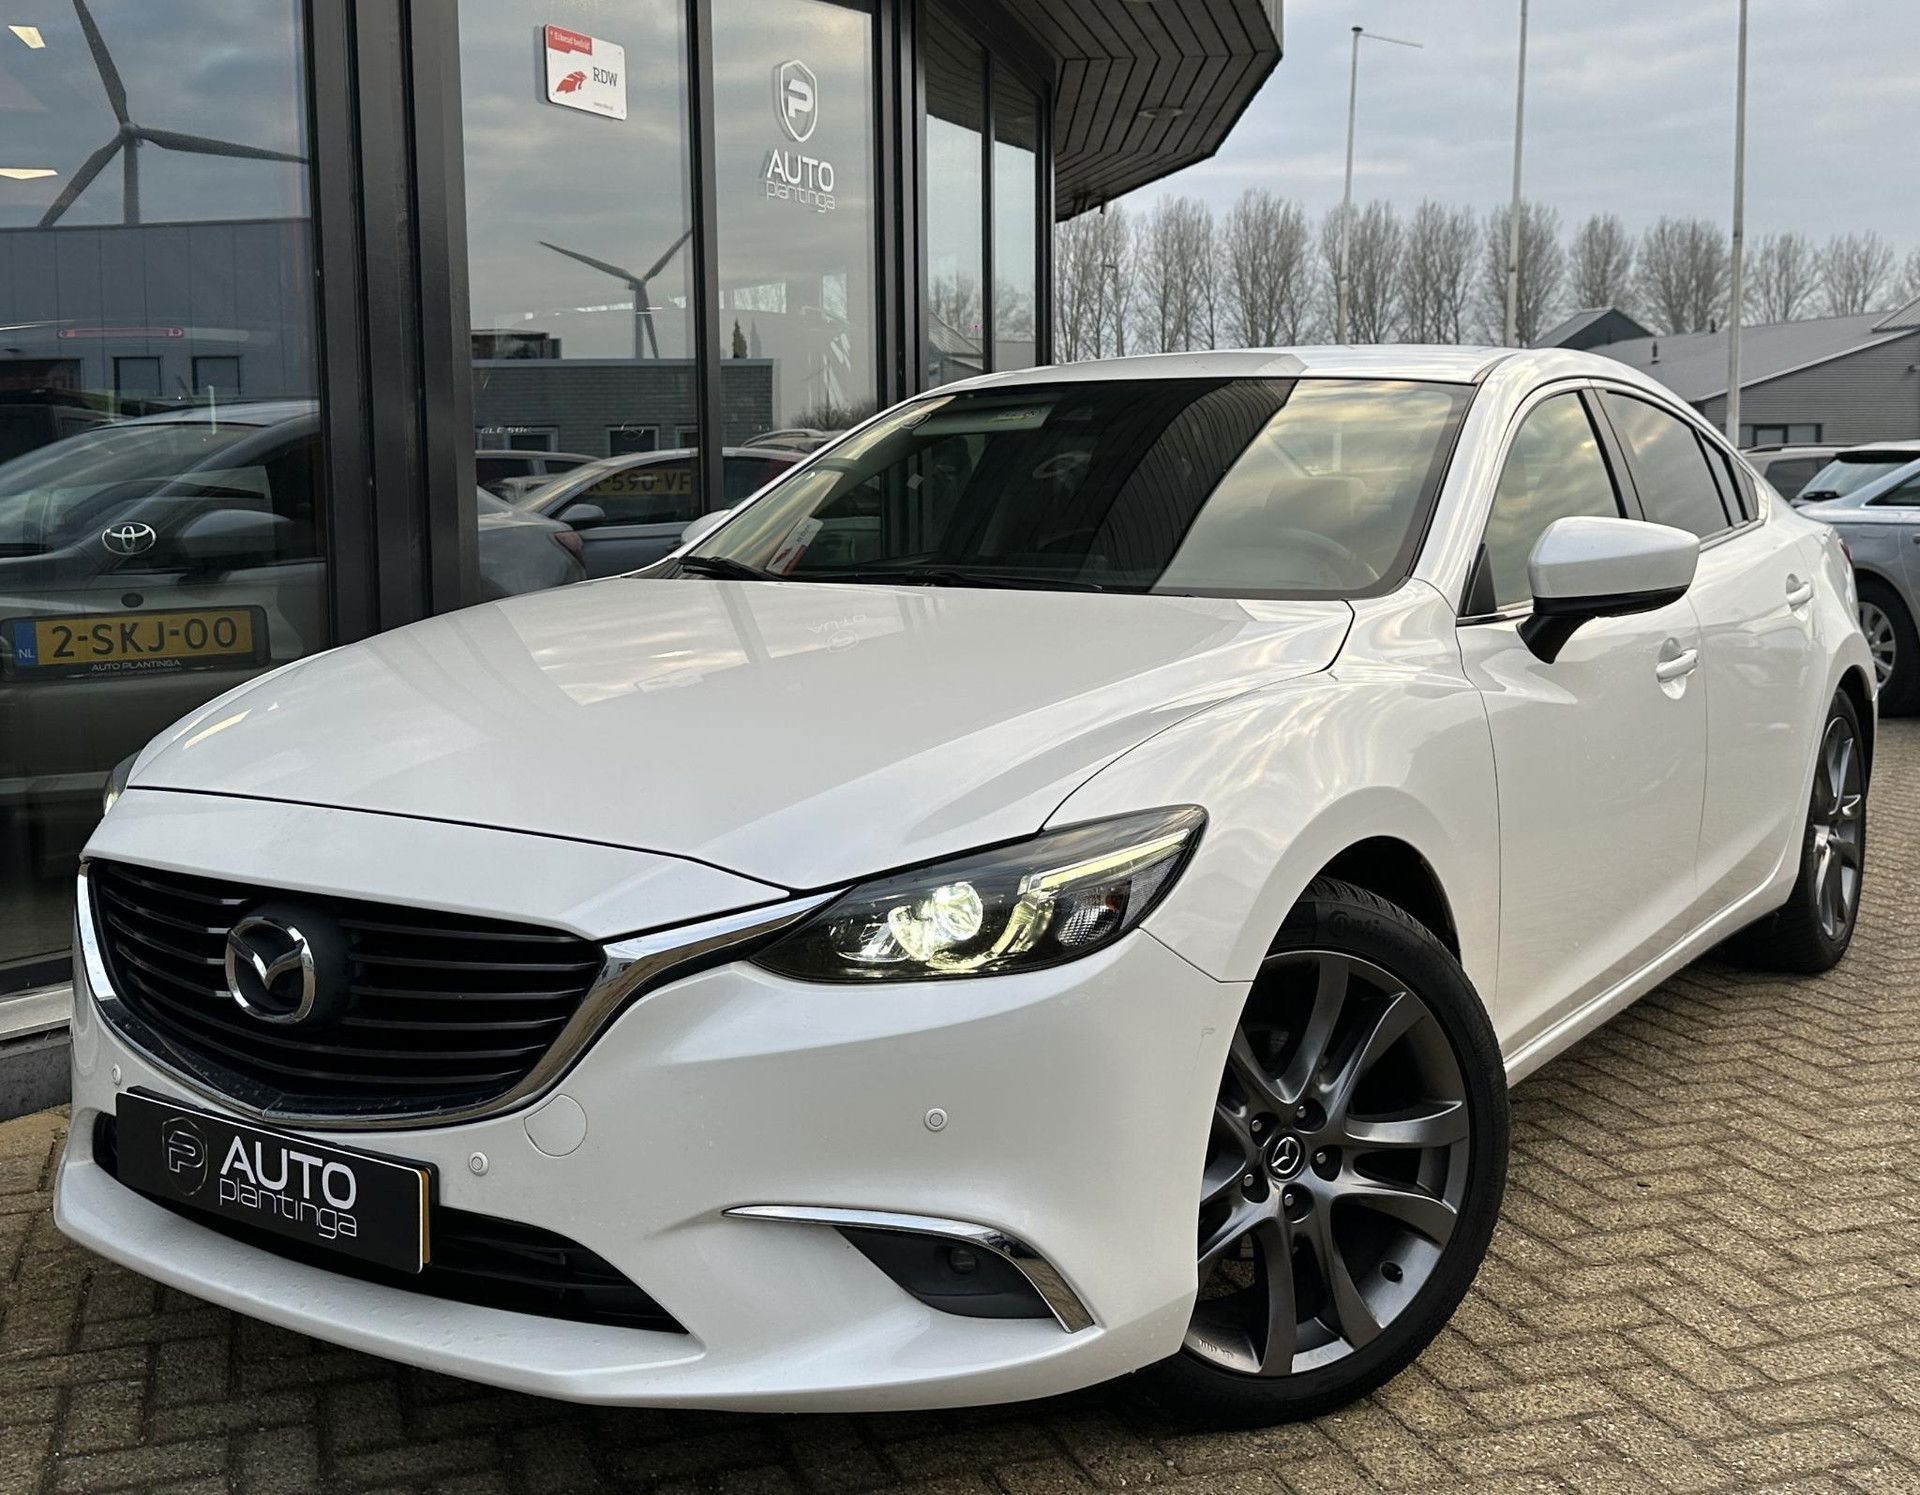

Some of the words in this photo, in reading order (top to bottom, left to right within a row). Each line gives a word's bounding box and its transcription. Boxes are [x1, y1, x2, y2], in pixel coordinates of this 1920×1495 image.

[593, 66, 618, 87] RDW
[766, 148, 834, 192] AUTO
[18, 648, 36, 659] NL
[51, 616, 238, 658] 2-SKJ-00
[91, 663, 120, 672] AUTO
[122, 659, 182, 670] PLANTINGA
[220, 1135, 357, 1210] AUTO
[219, 1177, 358, 1239] plantinga
